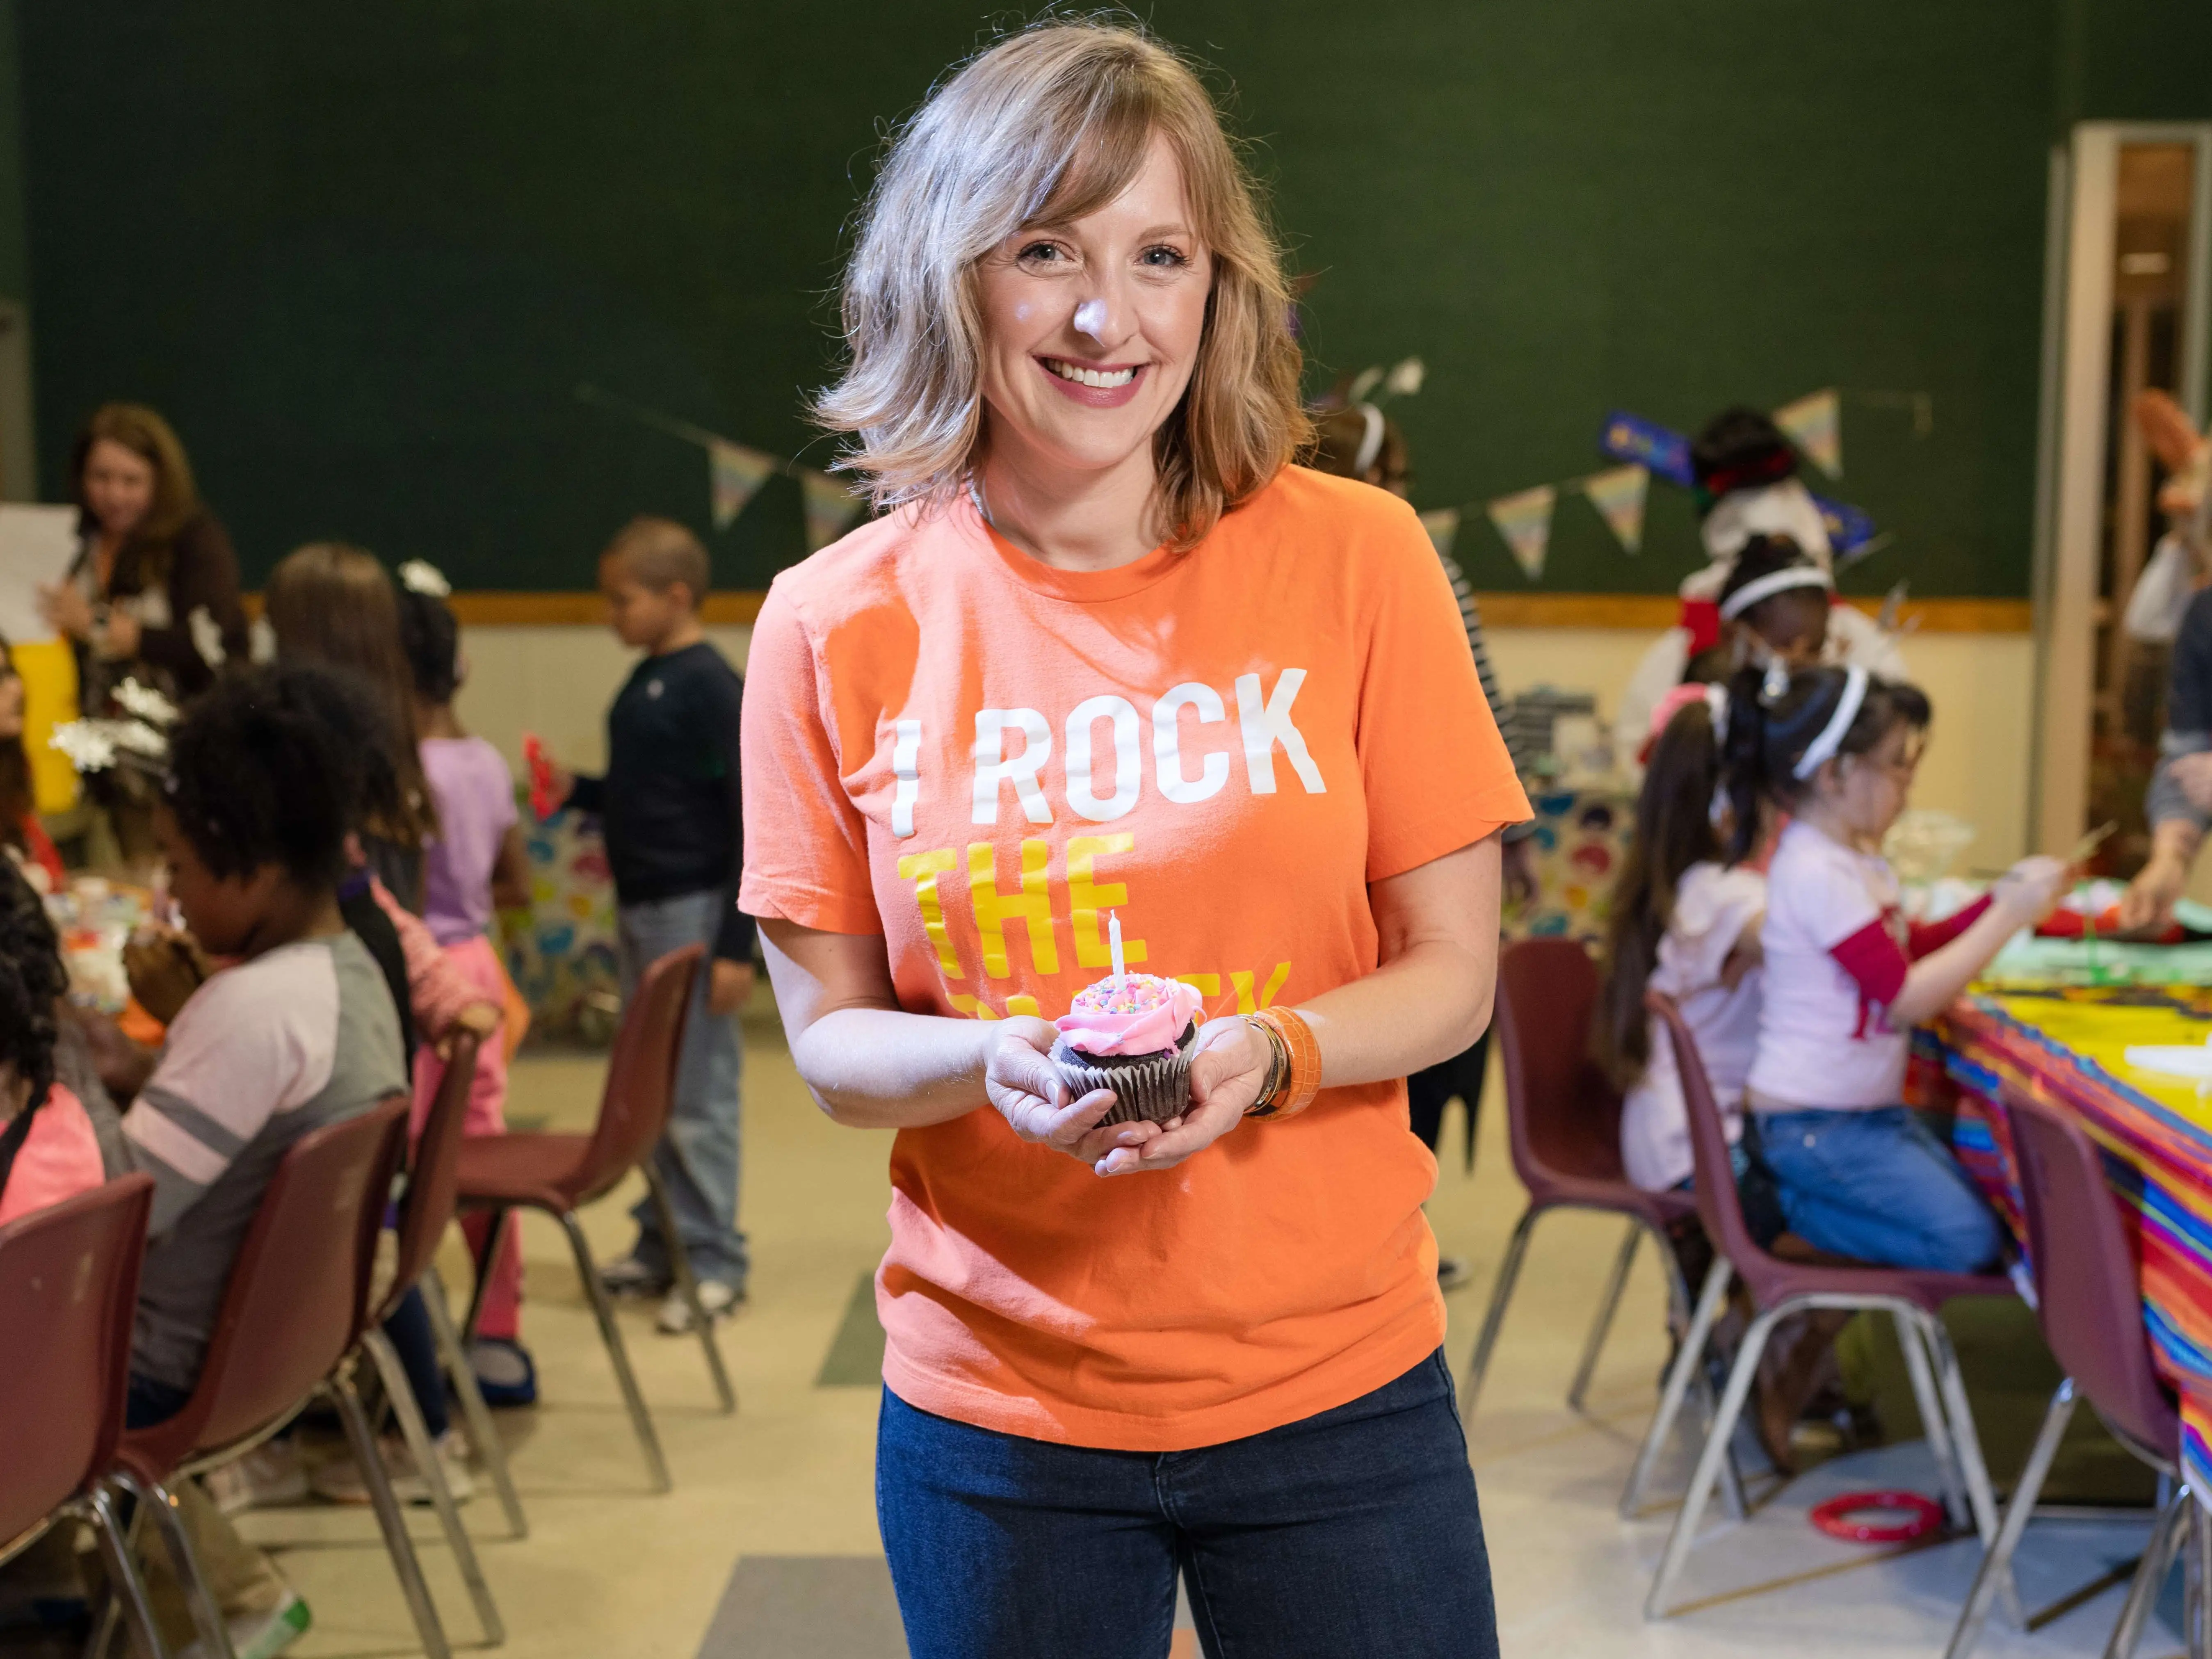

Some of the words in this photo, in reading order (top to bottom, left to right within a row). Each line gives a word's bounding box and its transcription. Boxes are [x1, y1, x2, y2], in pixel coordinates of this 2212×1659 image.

[891, 719, 921, 838] I
[971, 668, 1327, 825] ROCK
[898, 833, 1148, 980] THE
